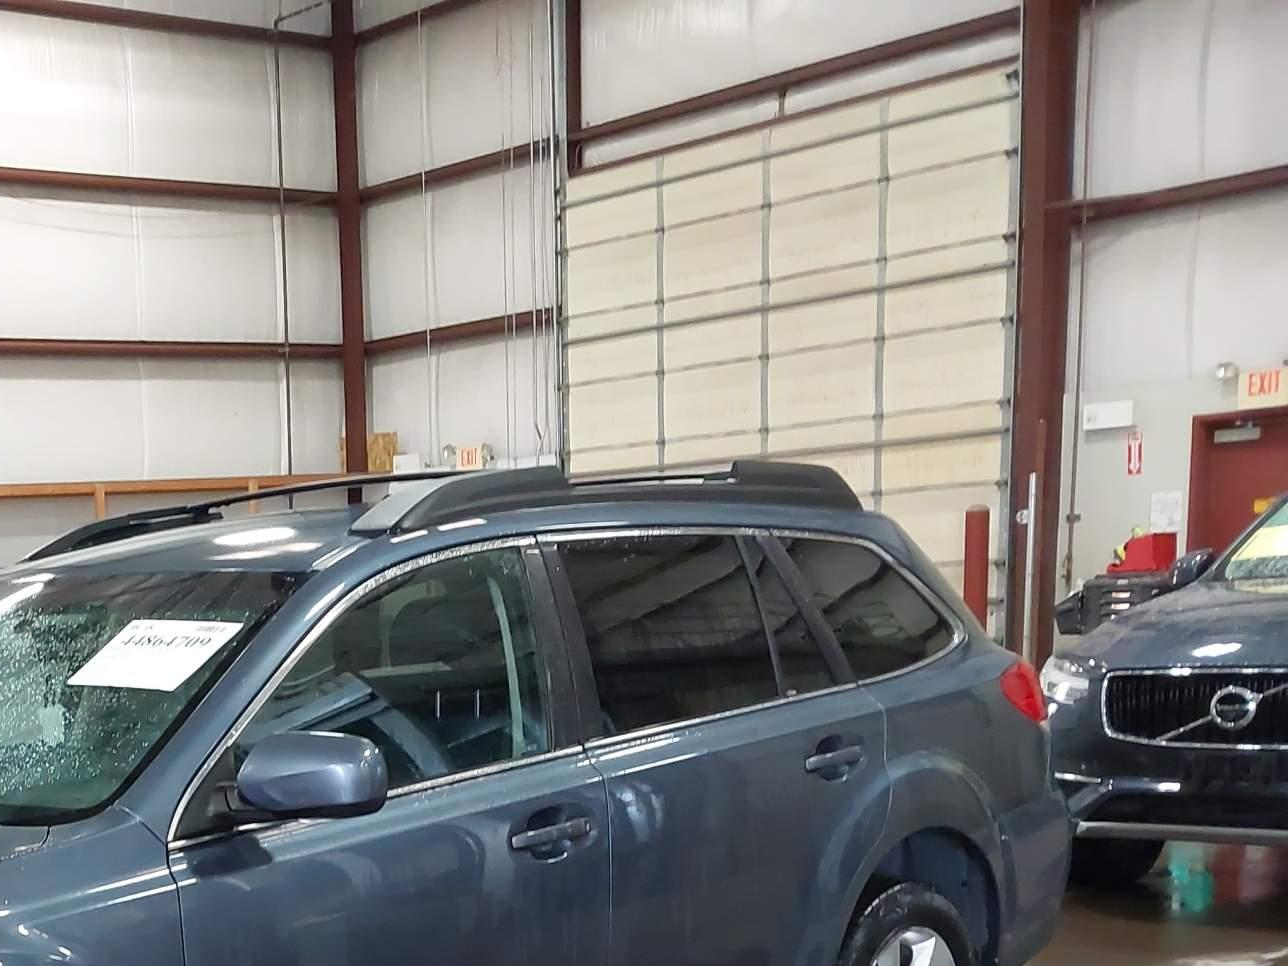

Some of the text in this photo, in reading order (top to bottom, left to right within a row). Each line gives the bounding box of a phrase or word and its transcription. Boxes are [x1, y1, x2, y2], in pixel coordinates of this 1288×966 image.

[1248, 369, 1281, 397] EXIT
[460, 448, 478, 466] EXIT
[120, 634, 213, 648] 44864709
